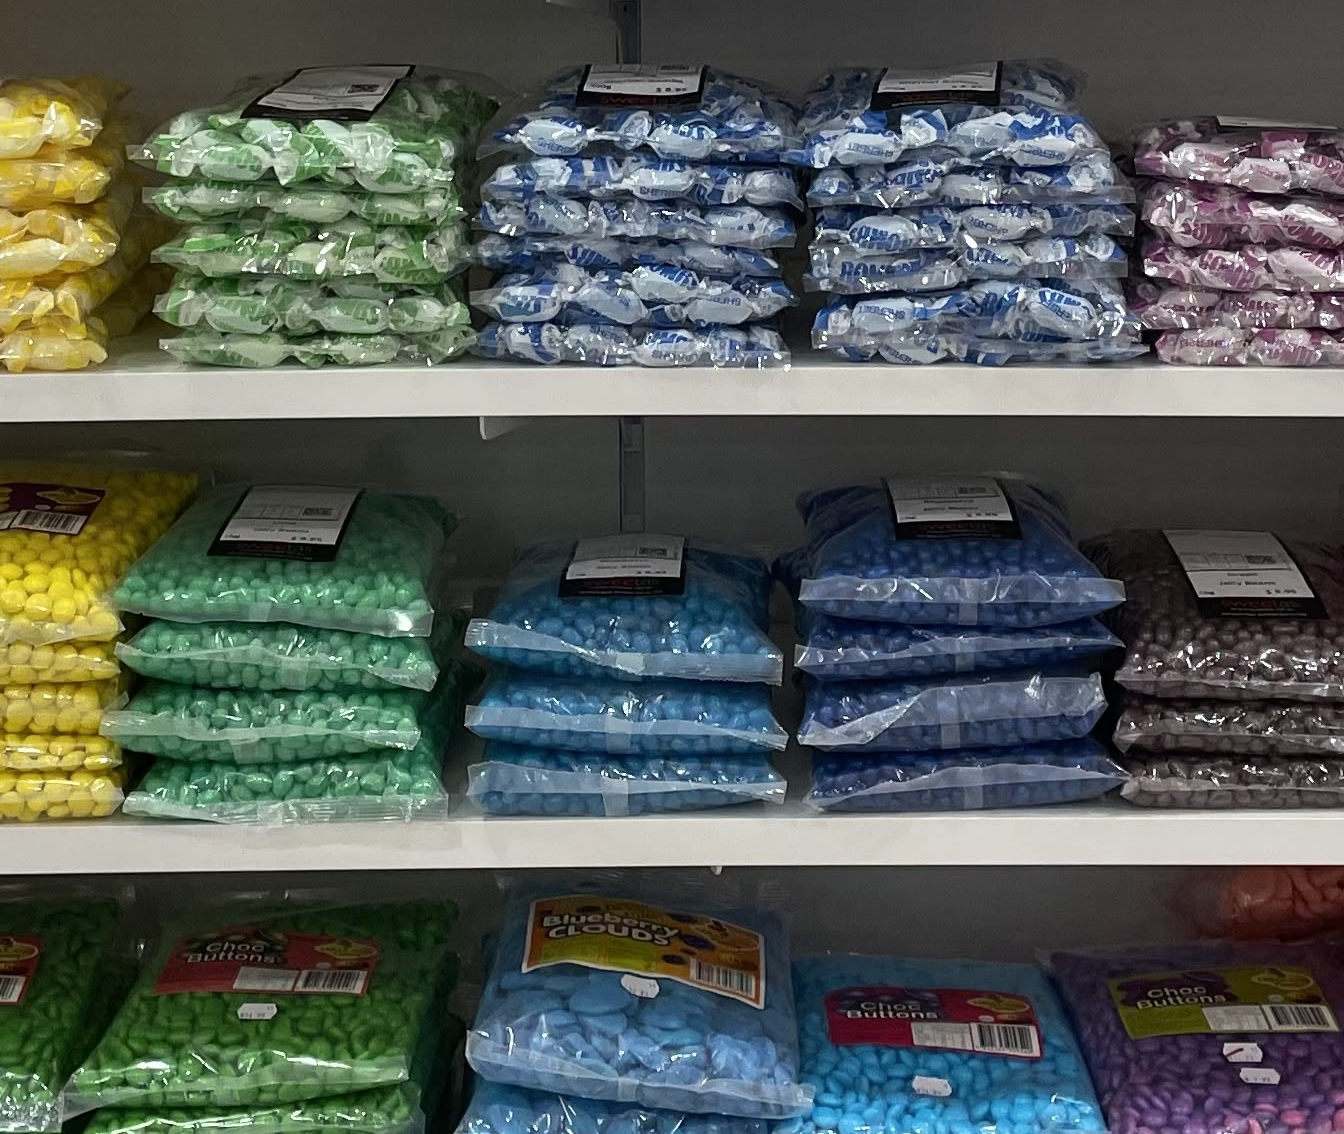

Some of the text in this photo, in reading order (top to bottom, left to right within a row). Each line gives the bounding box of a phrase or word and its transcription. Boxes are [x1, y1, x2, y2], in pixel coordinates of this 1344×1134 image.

[543, 913, 681, 938] Blueberry
[549, 924, 670, 946] CLOUDS
[206, 941, 265, 953] Choc
[187, 953, 275, 964] Buttons
[1147, 986, 1207, 998] Choc
[860, 1001, 921, 1011] Choc
[1136, 994, 1227, 1010] Buttons
[846, 1009, 938, 1020] Buttons
